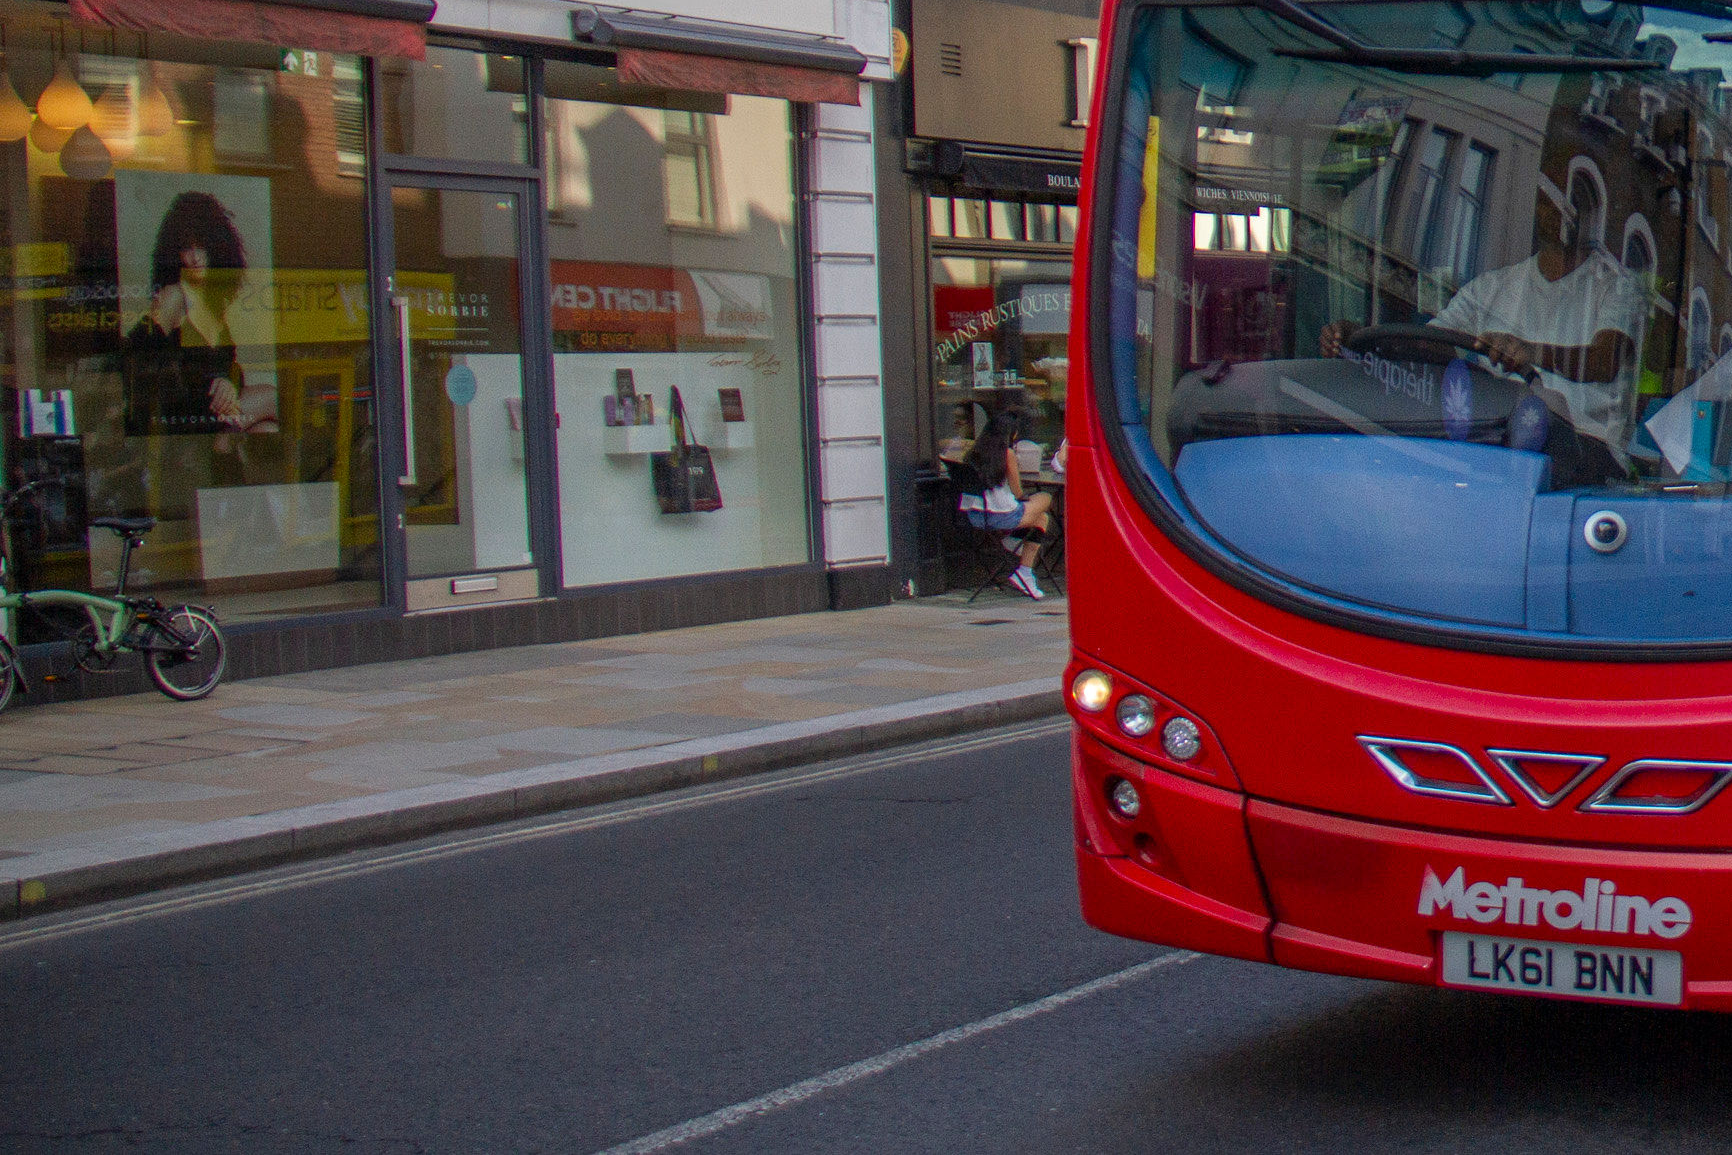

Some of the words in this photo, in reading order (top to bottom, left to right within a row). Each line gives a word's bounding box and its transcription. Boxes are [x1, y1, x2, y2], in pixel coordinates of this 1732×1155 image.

[427, 292, 489, 304] TREVOR
[427, 305, 489, 317] SORBIE
[937, 318, 979, 363] PAINS
[980, 293, 1060, 332] RUSTIQUES
[1417, 863, 1693, 938] Metroline
[1467, 940, 1553, 987] LK61
[1574, 950, 1654, 996] BNN
